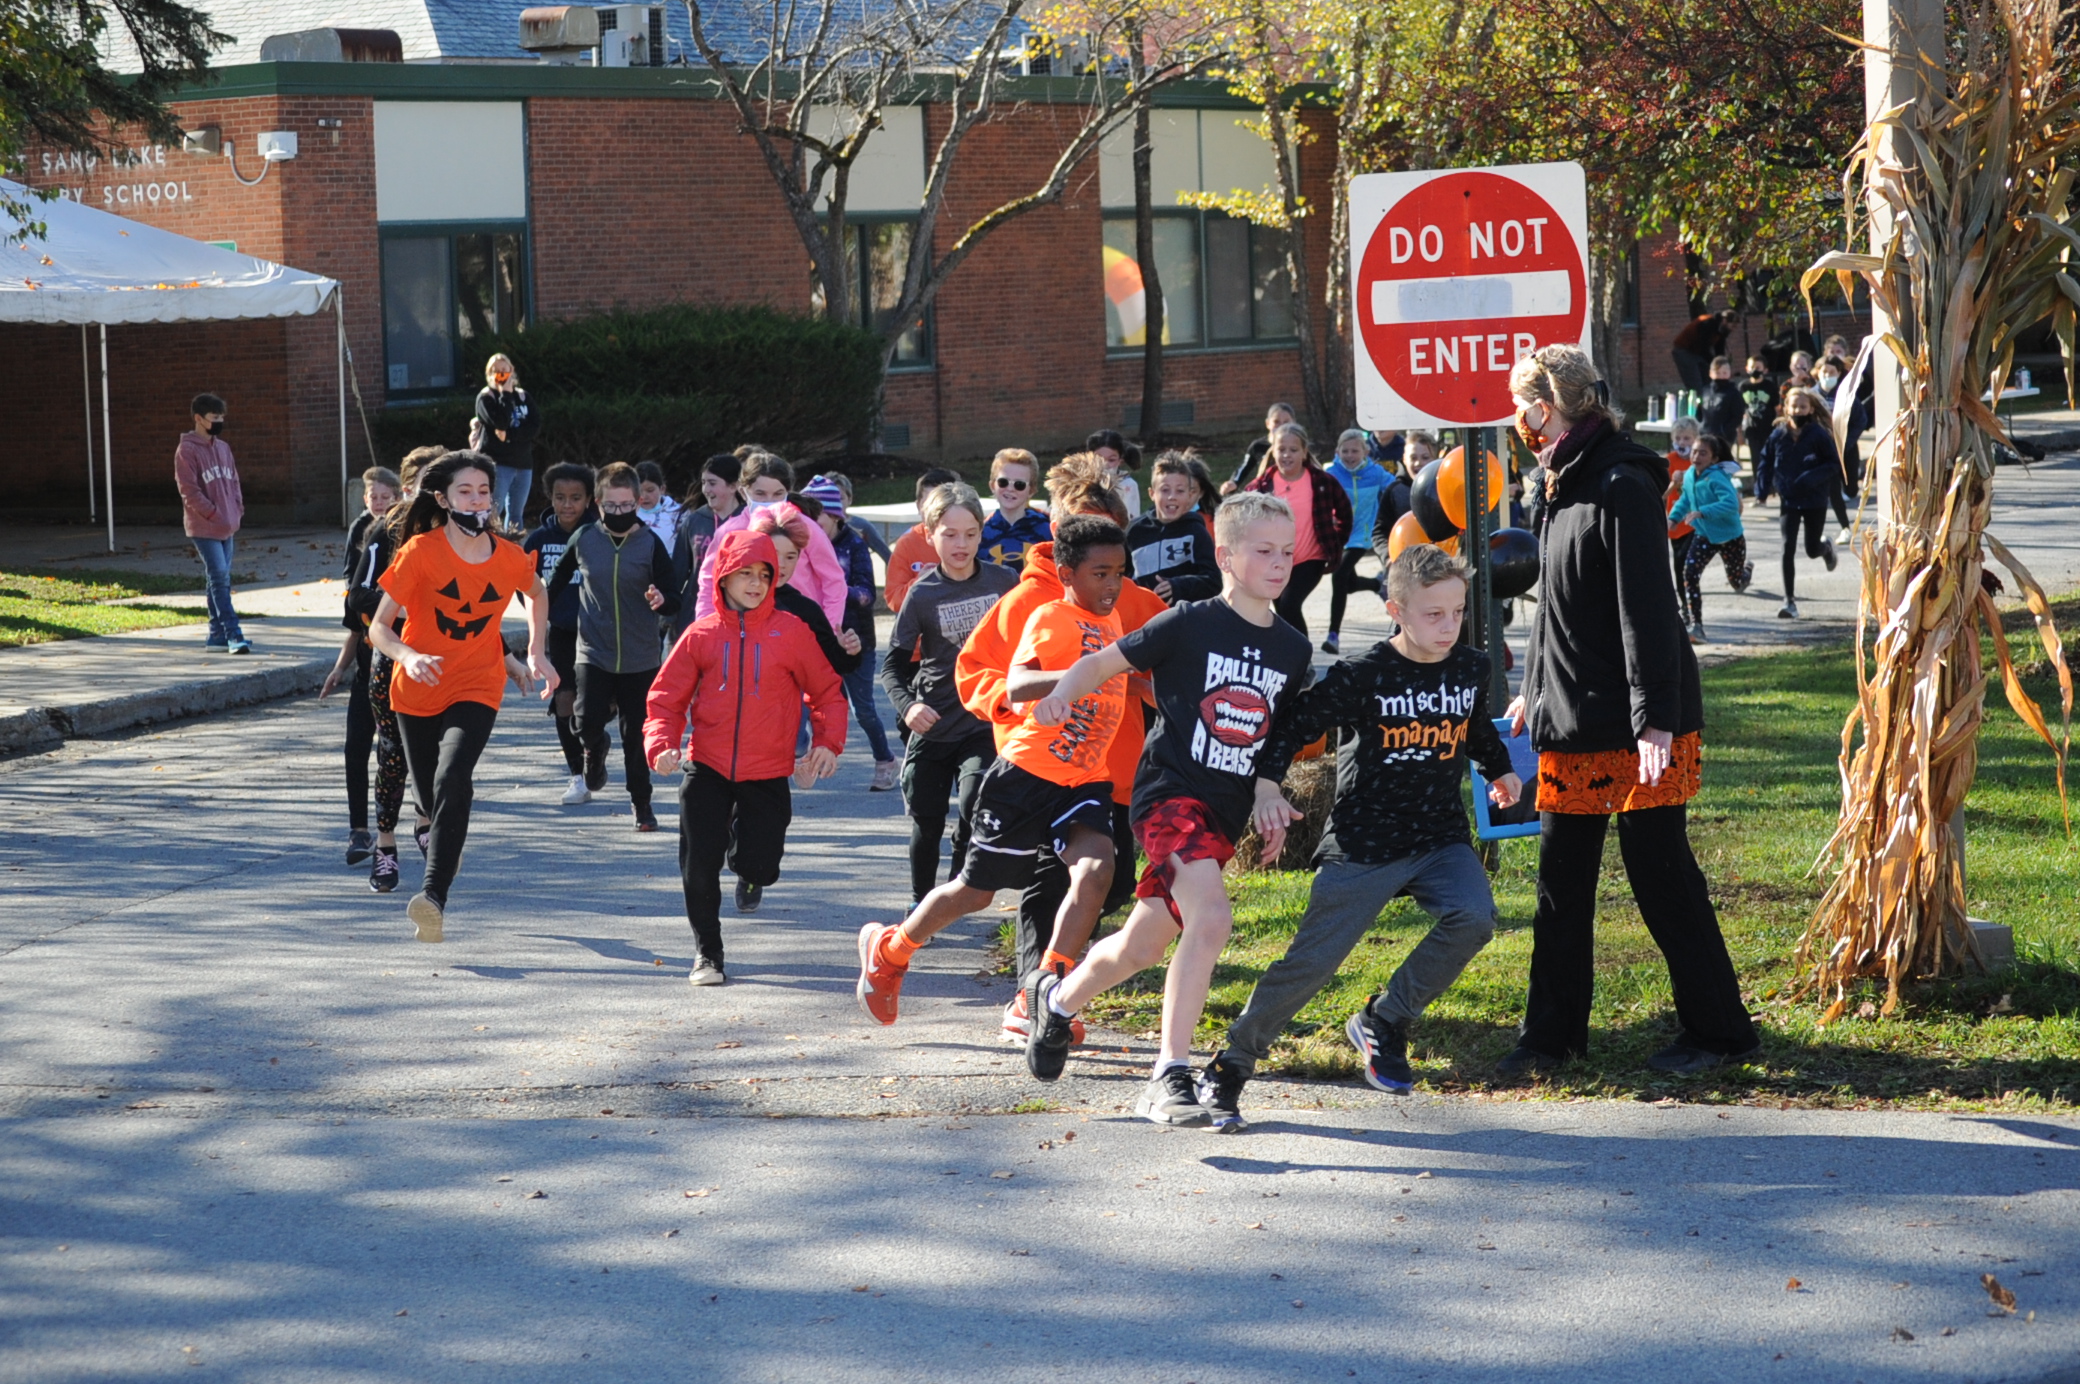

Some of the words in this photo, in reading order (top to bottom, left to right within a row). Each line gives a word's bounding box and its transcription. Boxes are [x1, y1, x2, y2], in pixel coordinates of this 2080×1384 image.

[104, 181, 192, 204] SCHOOL
[1389, 225, 1444, 264] DO
[1469, 217, 1548, 260] NOT
[1409, 332, 1537, 375] ENTER
[940, 600, 981, 620] THERE'S
[946, 616, 974, 632] PLATE
[1204, 652, 1250, 692] BALL
[1251, 665, 1288, 714] LIKE
[1048, 698, 1098, 763] GAME
[1191, 717, 1207, 763] A
